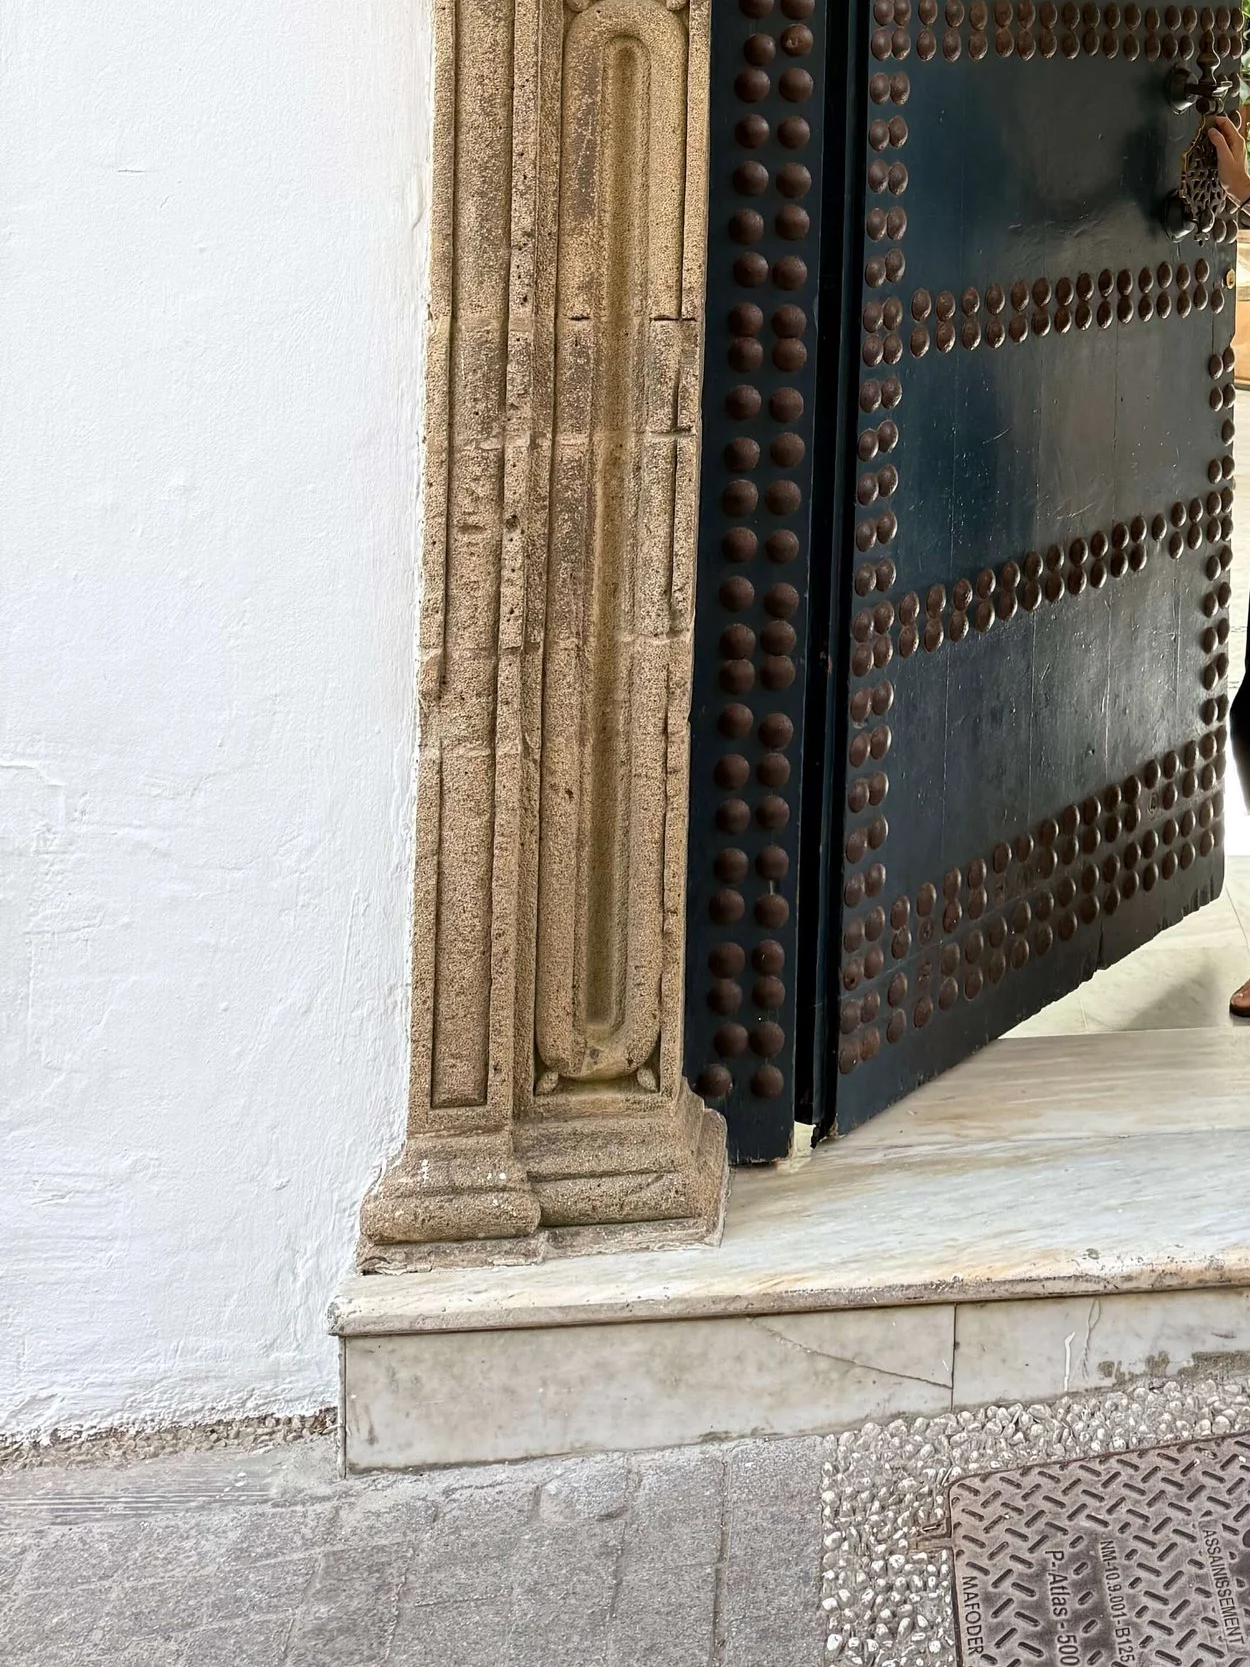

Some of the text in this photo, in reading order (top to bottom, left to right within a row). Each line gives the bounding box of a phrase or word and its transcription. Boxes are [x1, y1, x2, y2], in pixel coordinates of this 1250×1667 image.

[962, 1576, 984, 1655] MAFODER
[1202, 1529, 1245, 1645] ASSAINISSEMENT
[1057, 1634, 1081, 1666] 500
